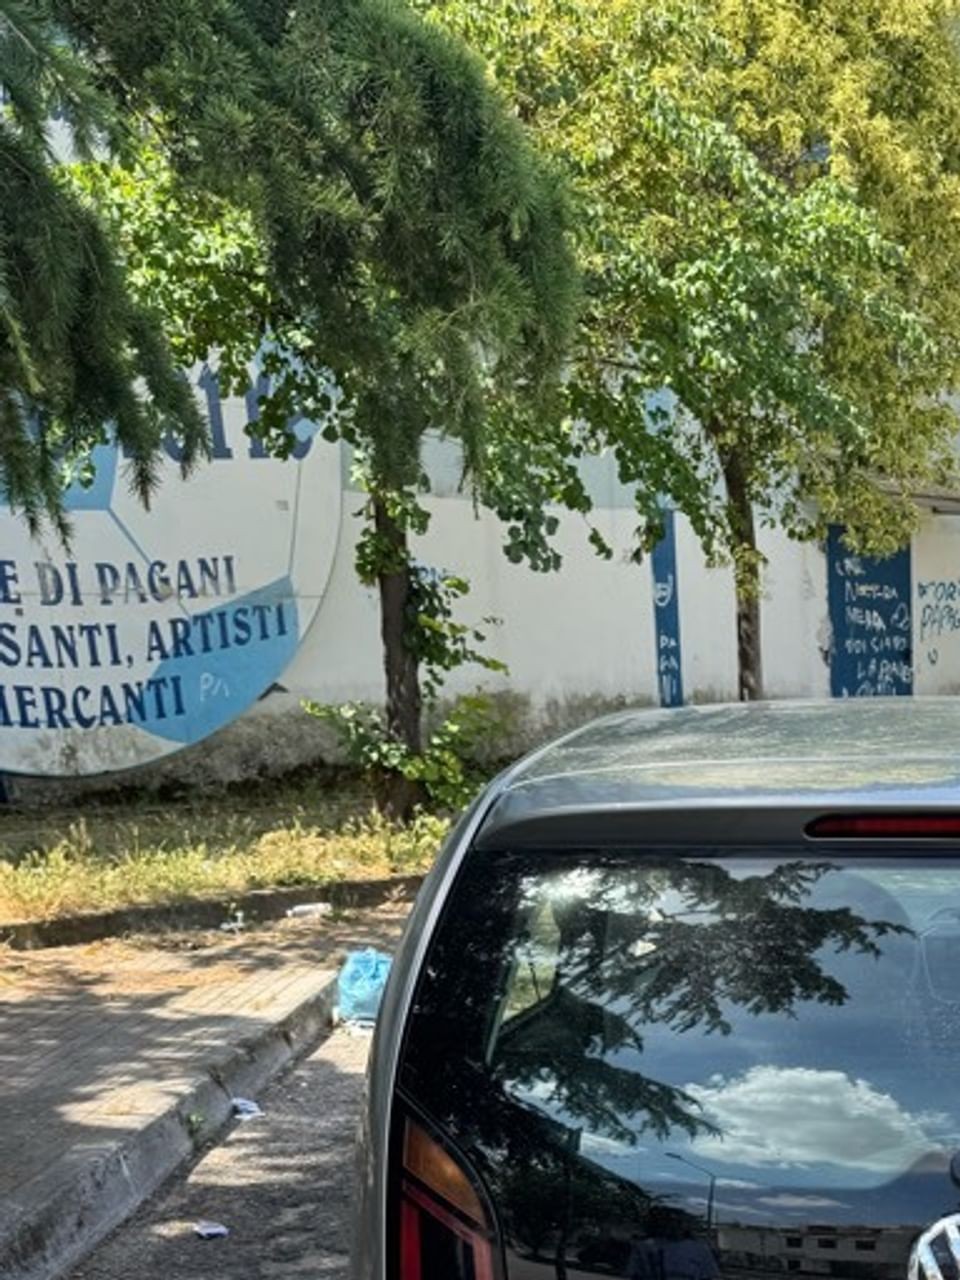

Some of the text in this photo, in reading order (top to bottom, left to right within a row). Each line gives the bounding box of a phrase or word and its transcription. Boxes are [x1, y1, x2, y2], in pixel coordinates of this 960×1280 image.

[34, 561, 83, 606] DI
[95, 556, 236, 605] PAGANI
[0, 603, 288, 669] SANTI, ARTISTI
